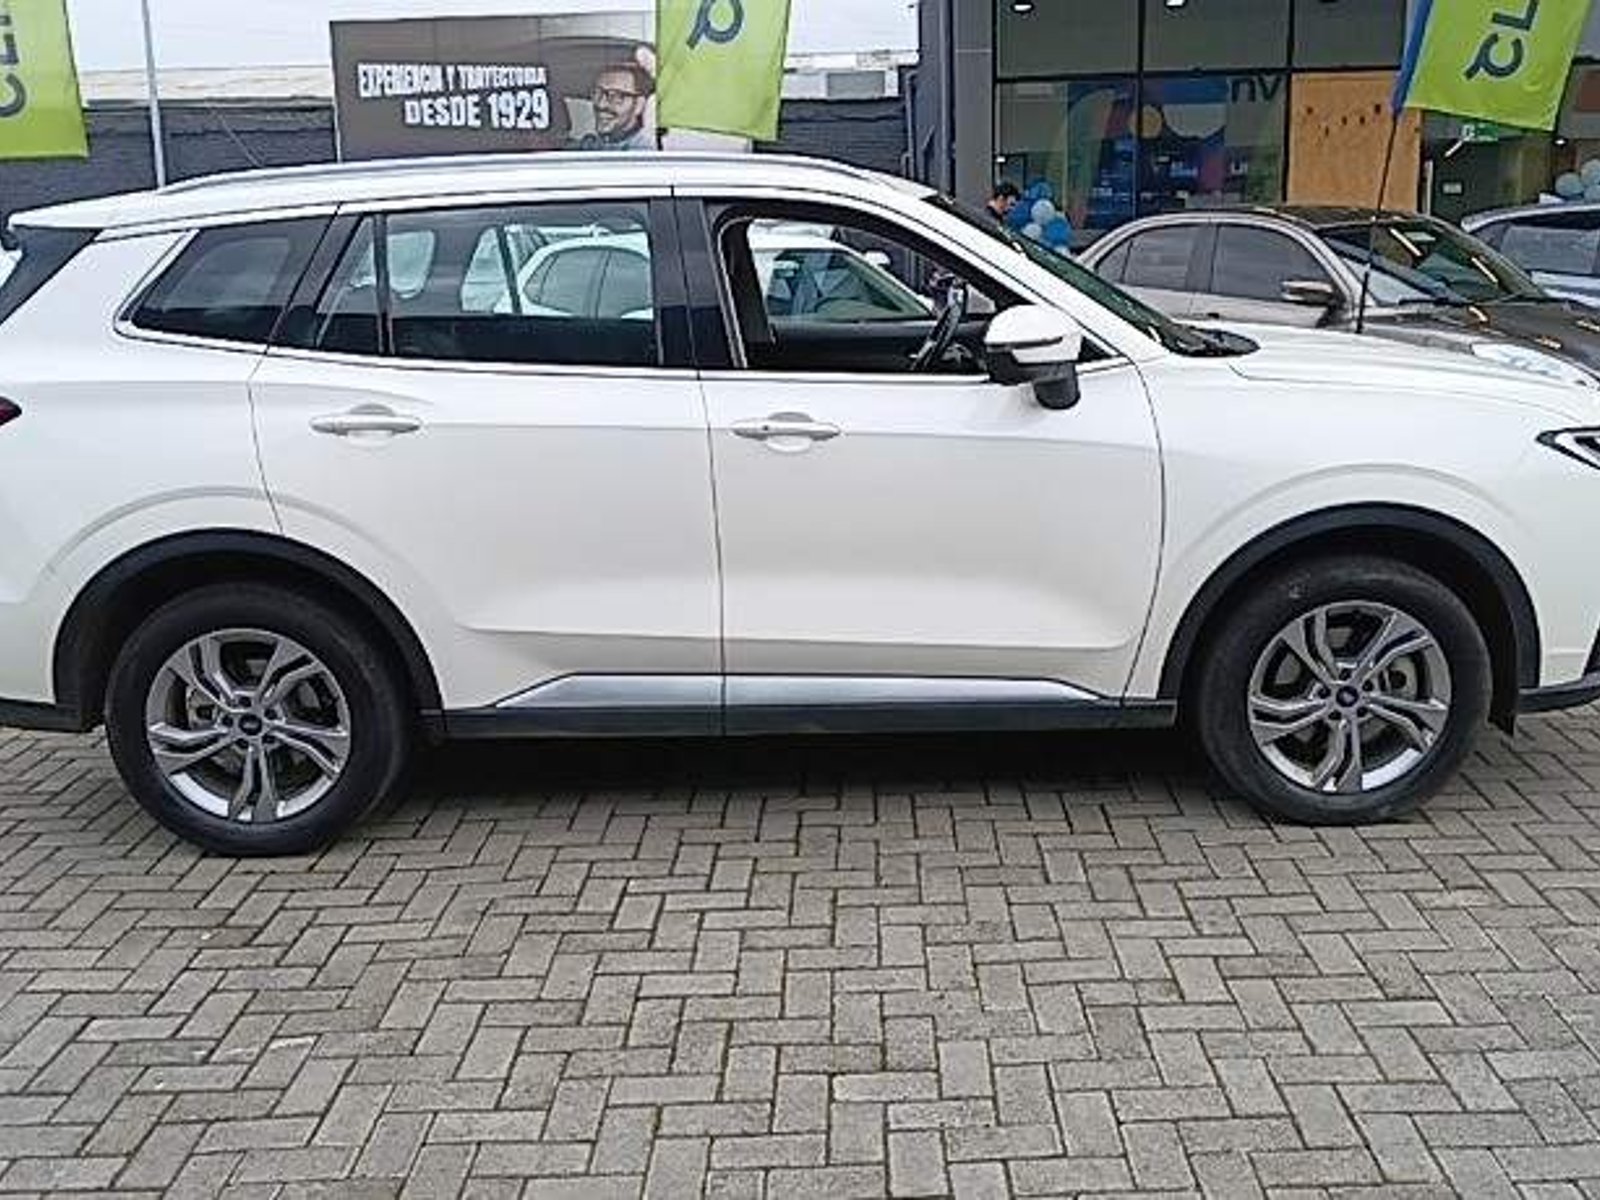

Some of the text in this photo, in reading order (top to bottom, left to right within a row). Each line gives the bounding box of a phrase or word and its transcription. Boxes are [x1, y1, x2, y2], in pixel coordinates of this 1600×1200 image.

[357, 64, 547, 97] EXPERIENCIA Y TRAYECTORIA
[404, 88, 549, 129] DESDE 1929
